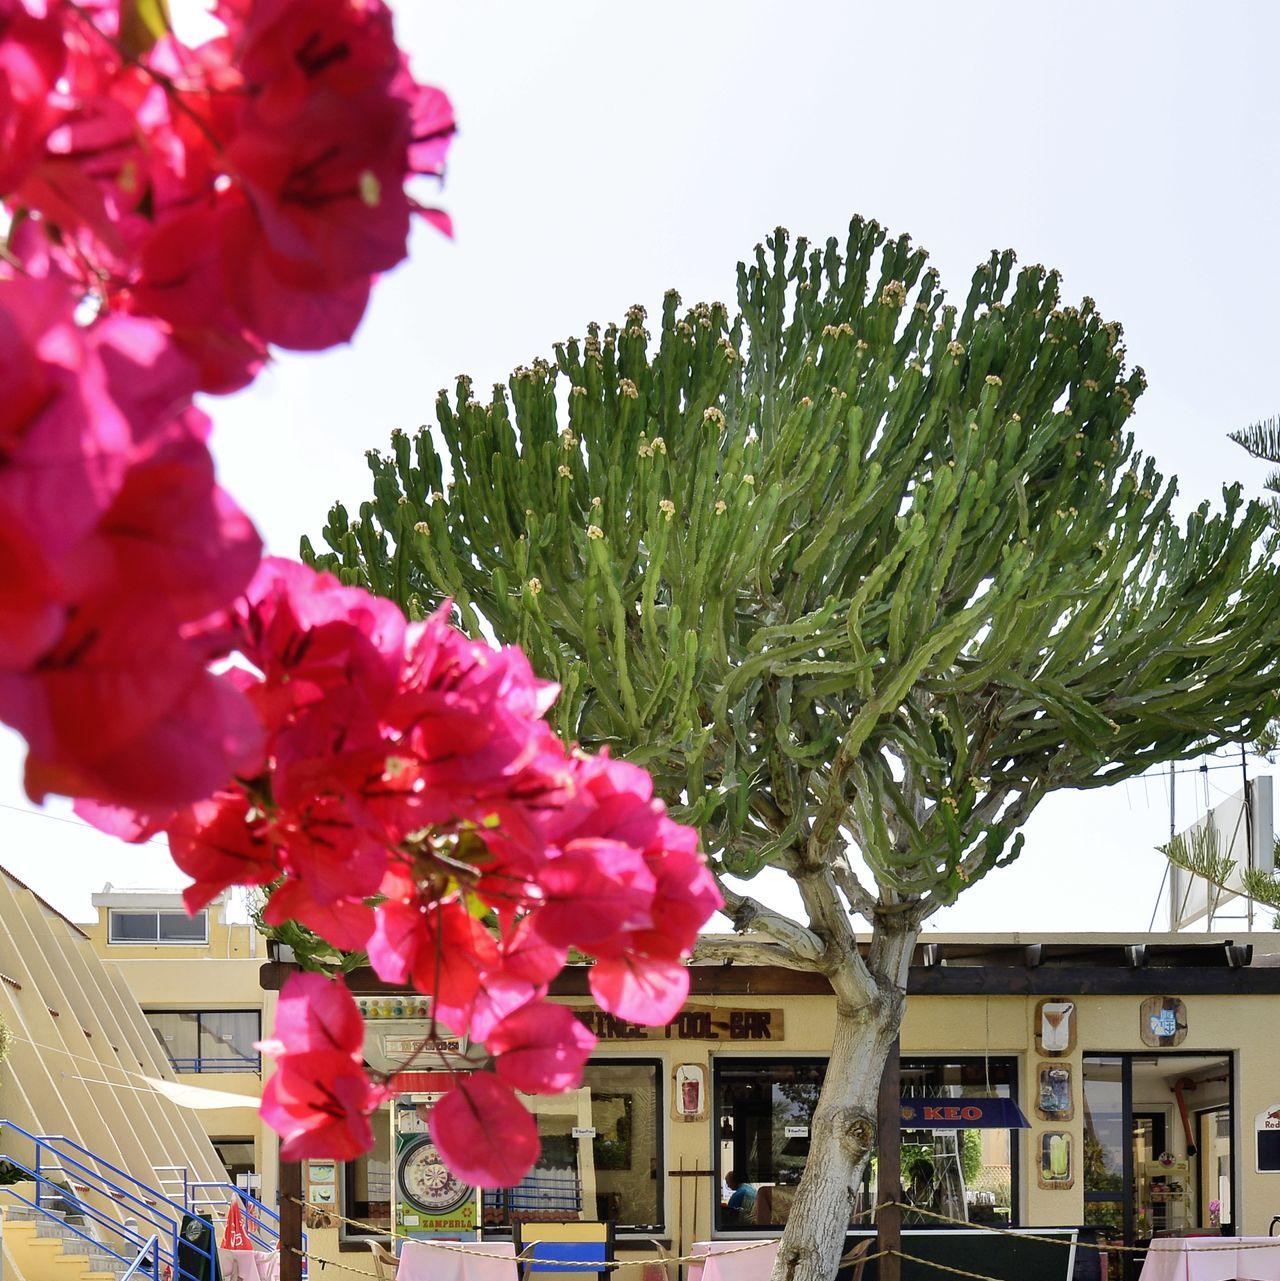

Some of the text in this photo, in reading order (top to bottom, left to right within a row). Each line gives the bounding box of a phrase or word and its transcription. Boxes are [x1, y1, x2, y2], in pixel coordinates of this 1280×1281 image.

[729, 1011, 771, 1039] BAR
[923, 1106, 982, 1120] KEO
[423, 1220, 472, 1228] ZAMPERLA
